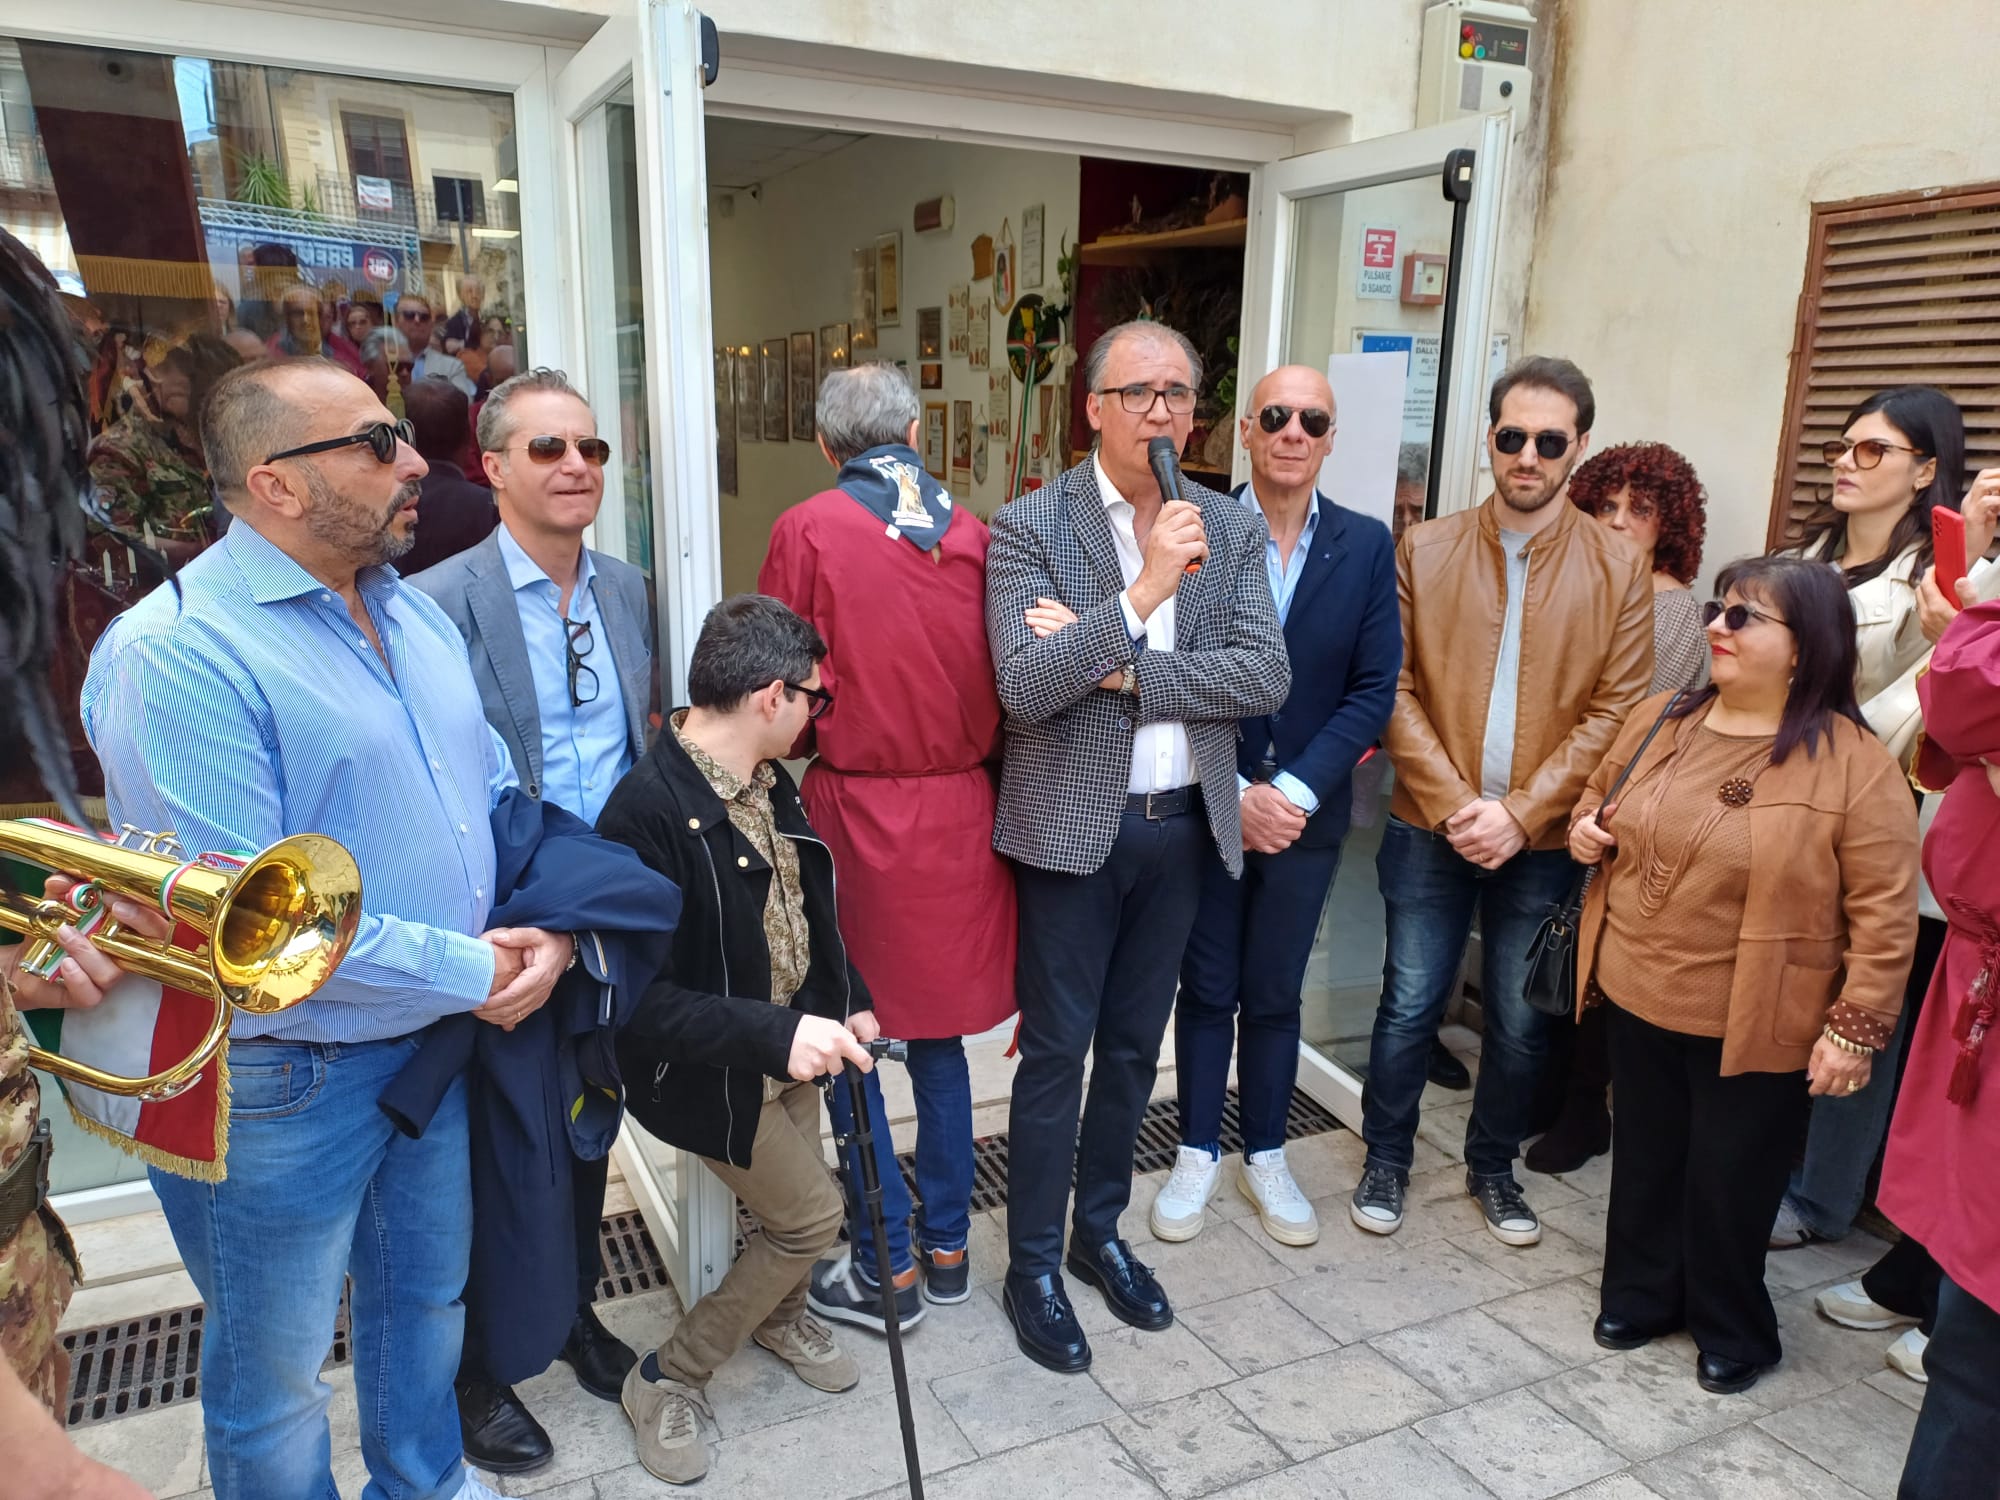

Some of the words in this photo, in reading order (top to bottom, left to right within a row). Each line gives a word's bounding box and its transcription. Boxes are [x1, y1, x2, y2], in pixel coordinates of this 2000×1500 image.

[1364, 270, 1392, 281] PULSANTE
[1368, 283, 1392, 294] SGANCIO
[1416, 338, 1440, 346] PROGE
